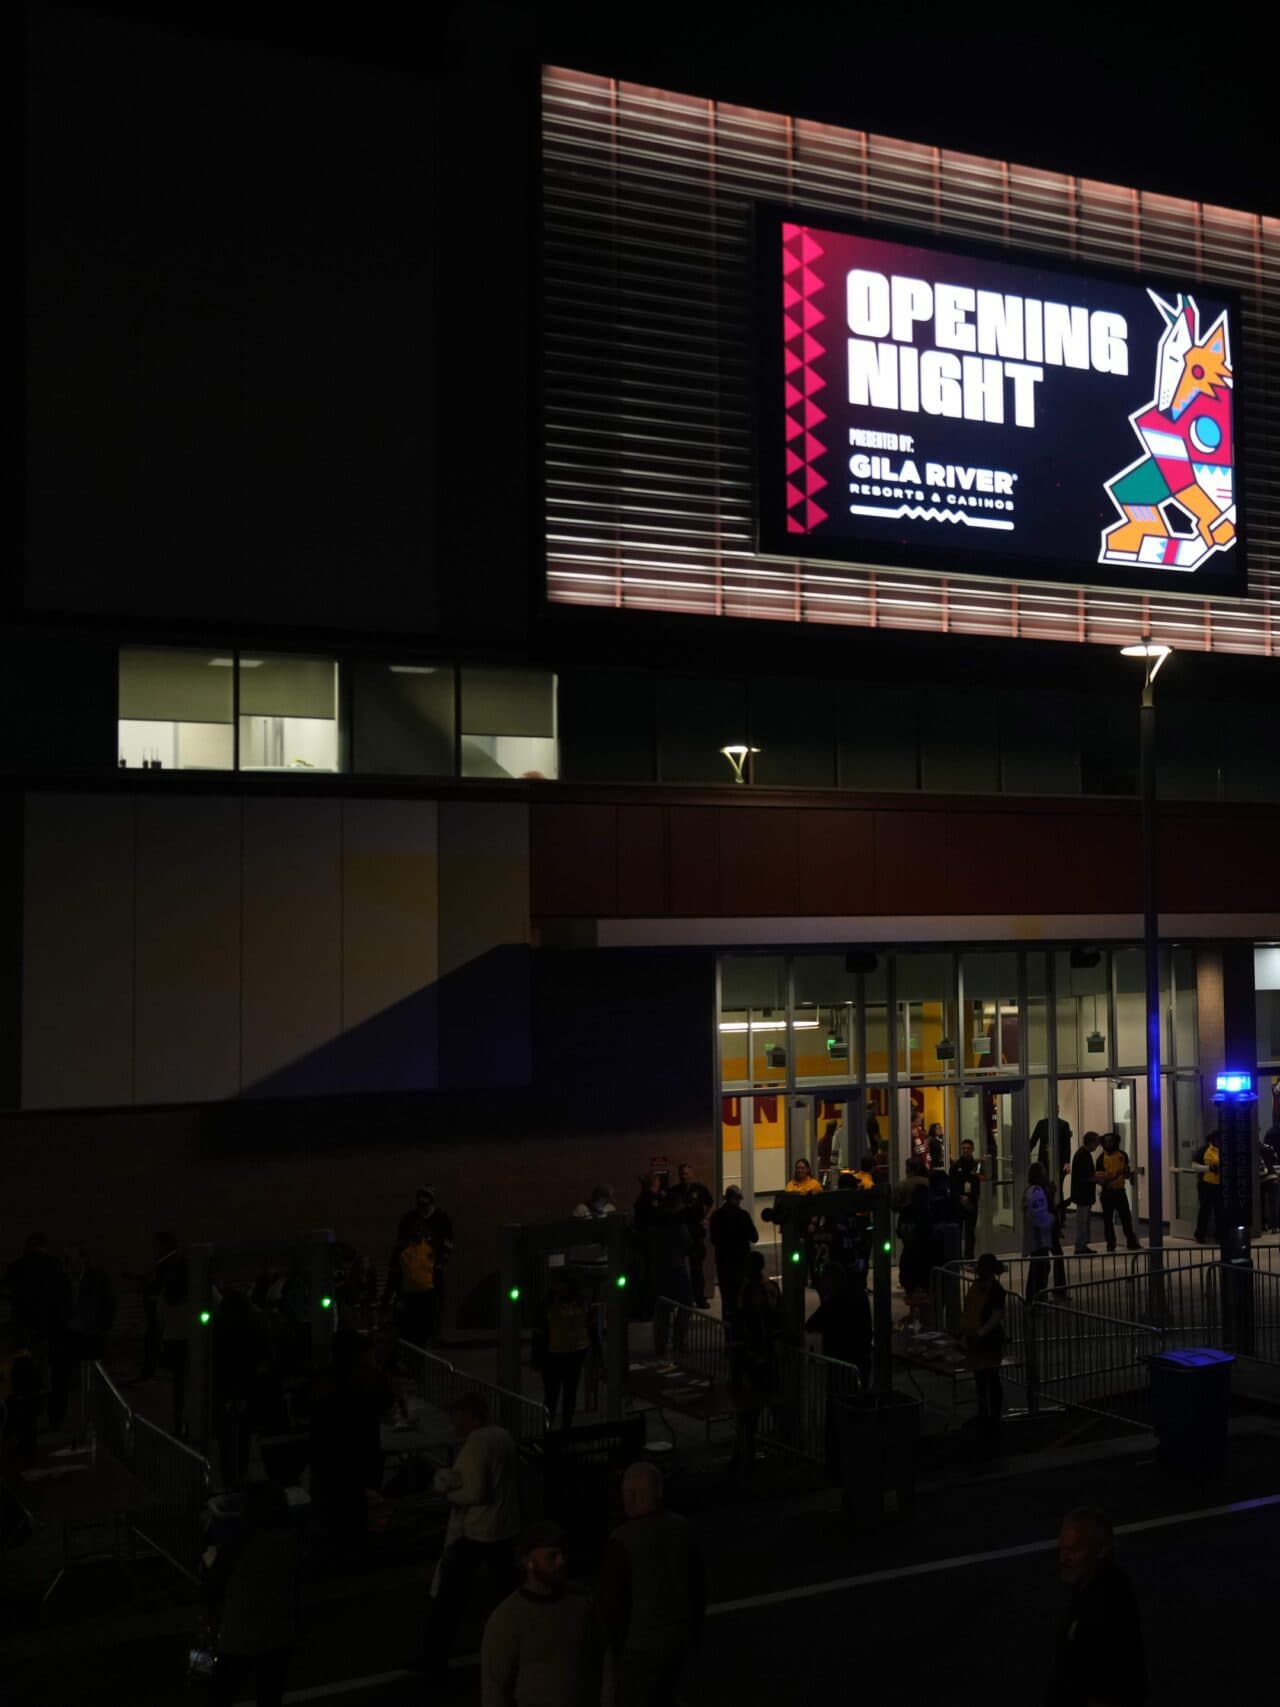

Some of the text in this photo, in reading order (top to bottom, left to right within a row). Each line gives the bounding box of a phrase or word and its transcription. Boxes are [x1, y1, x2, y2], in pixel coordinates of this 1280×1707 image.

[846, 269, 1128, 375] OPENING
[847, 338, 1043, 427] NIGHT
[849, 428, 898, 450] PRESENTED
[849, 454, 921, 484] GILA
[849, 483, 1015, 511] RESORTS & CASINOS
